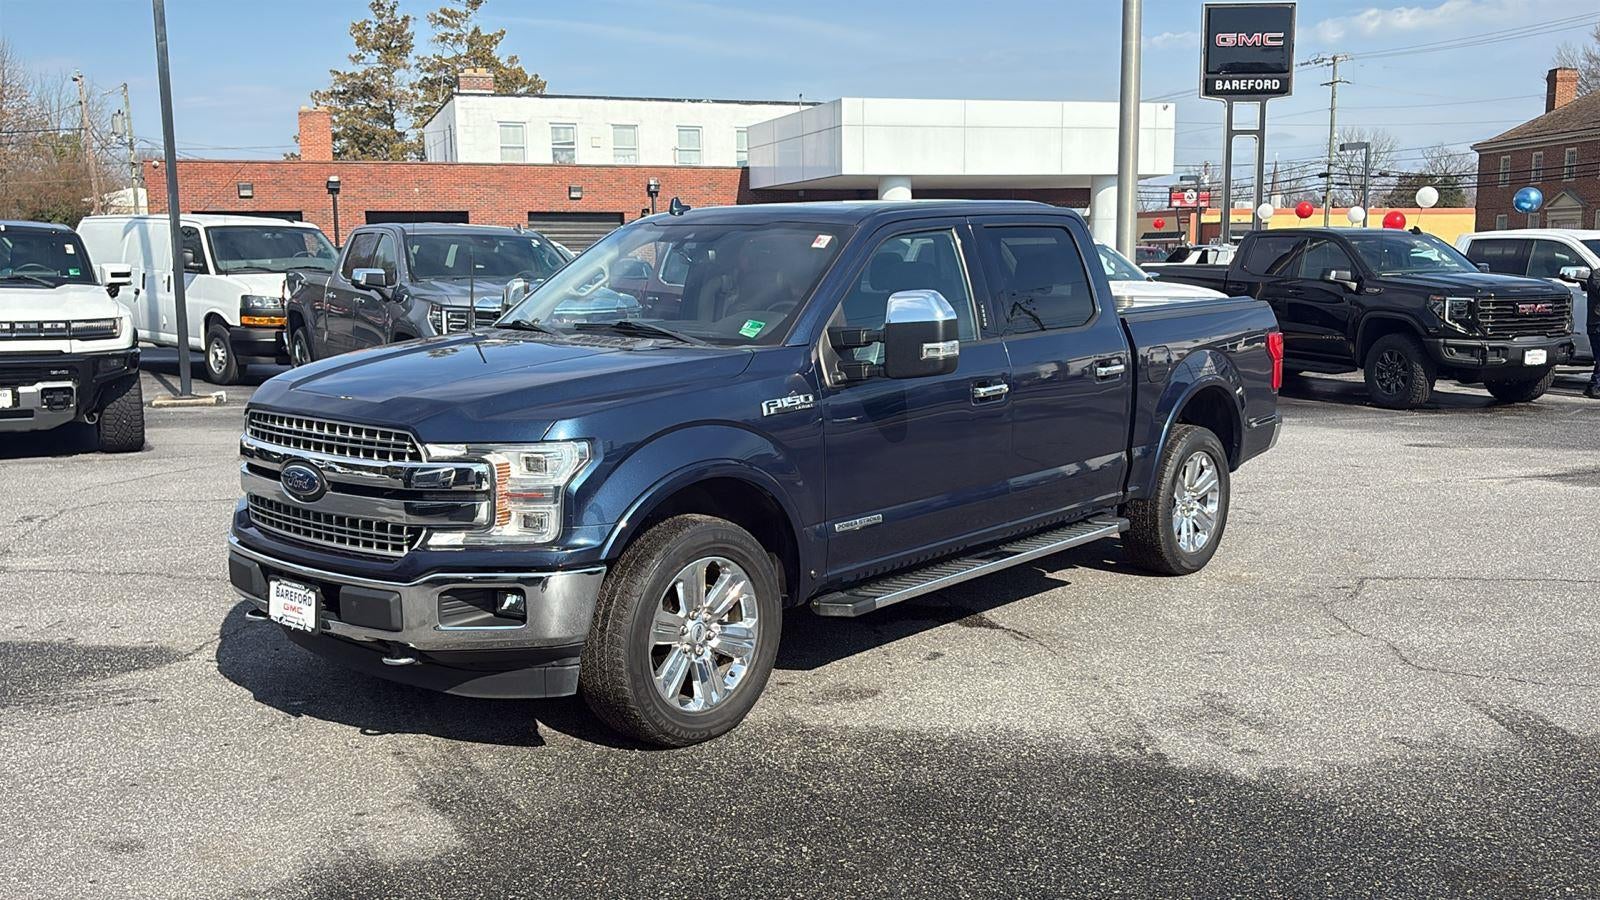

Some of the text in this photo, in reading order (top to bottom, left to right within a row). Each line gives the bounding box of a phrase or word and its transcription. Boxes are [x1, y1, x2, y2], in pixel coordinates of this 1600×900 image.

[1215, 32, 1284, 47] GMC
[1215, 79, 1280, 91] BAREFORD
[1518, 303, 1553, 313] GMC
[282, 471, 310, 490] Ford
[275, 585, 313, 607] BAREFORD
[283, 602, 303, 615] GMC
